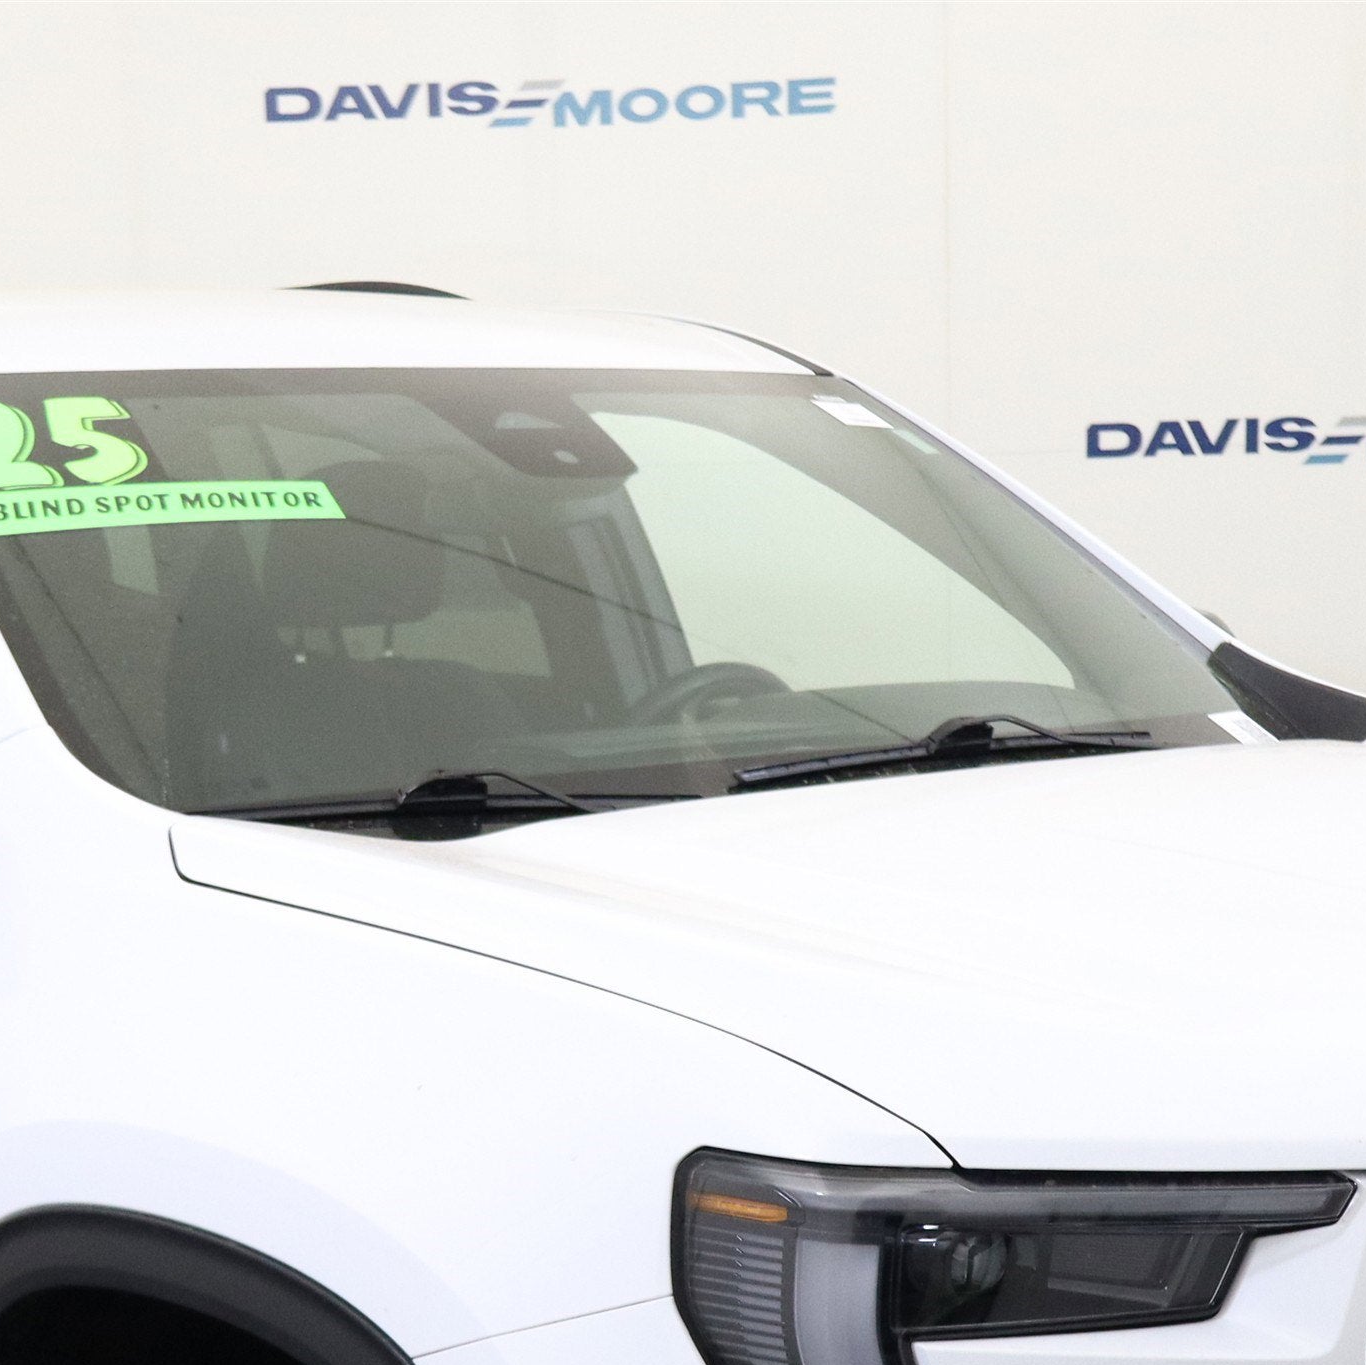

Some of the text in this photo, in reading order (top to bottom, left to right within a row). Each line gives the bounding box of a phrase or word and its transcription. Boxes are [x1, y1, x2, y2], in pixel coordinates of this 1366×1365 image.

[264, 77, 836, 127] DAVIS MOORE
[1086, 416, 1317, 458] DAVIS
[95, 493, 169, 514] SPOT
[180, 491, 324, 509] MONITOR
